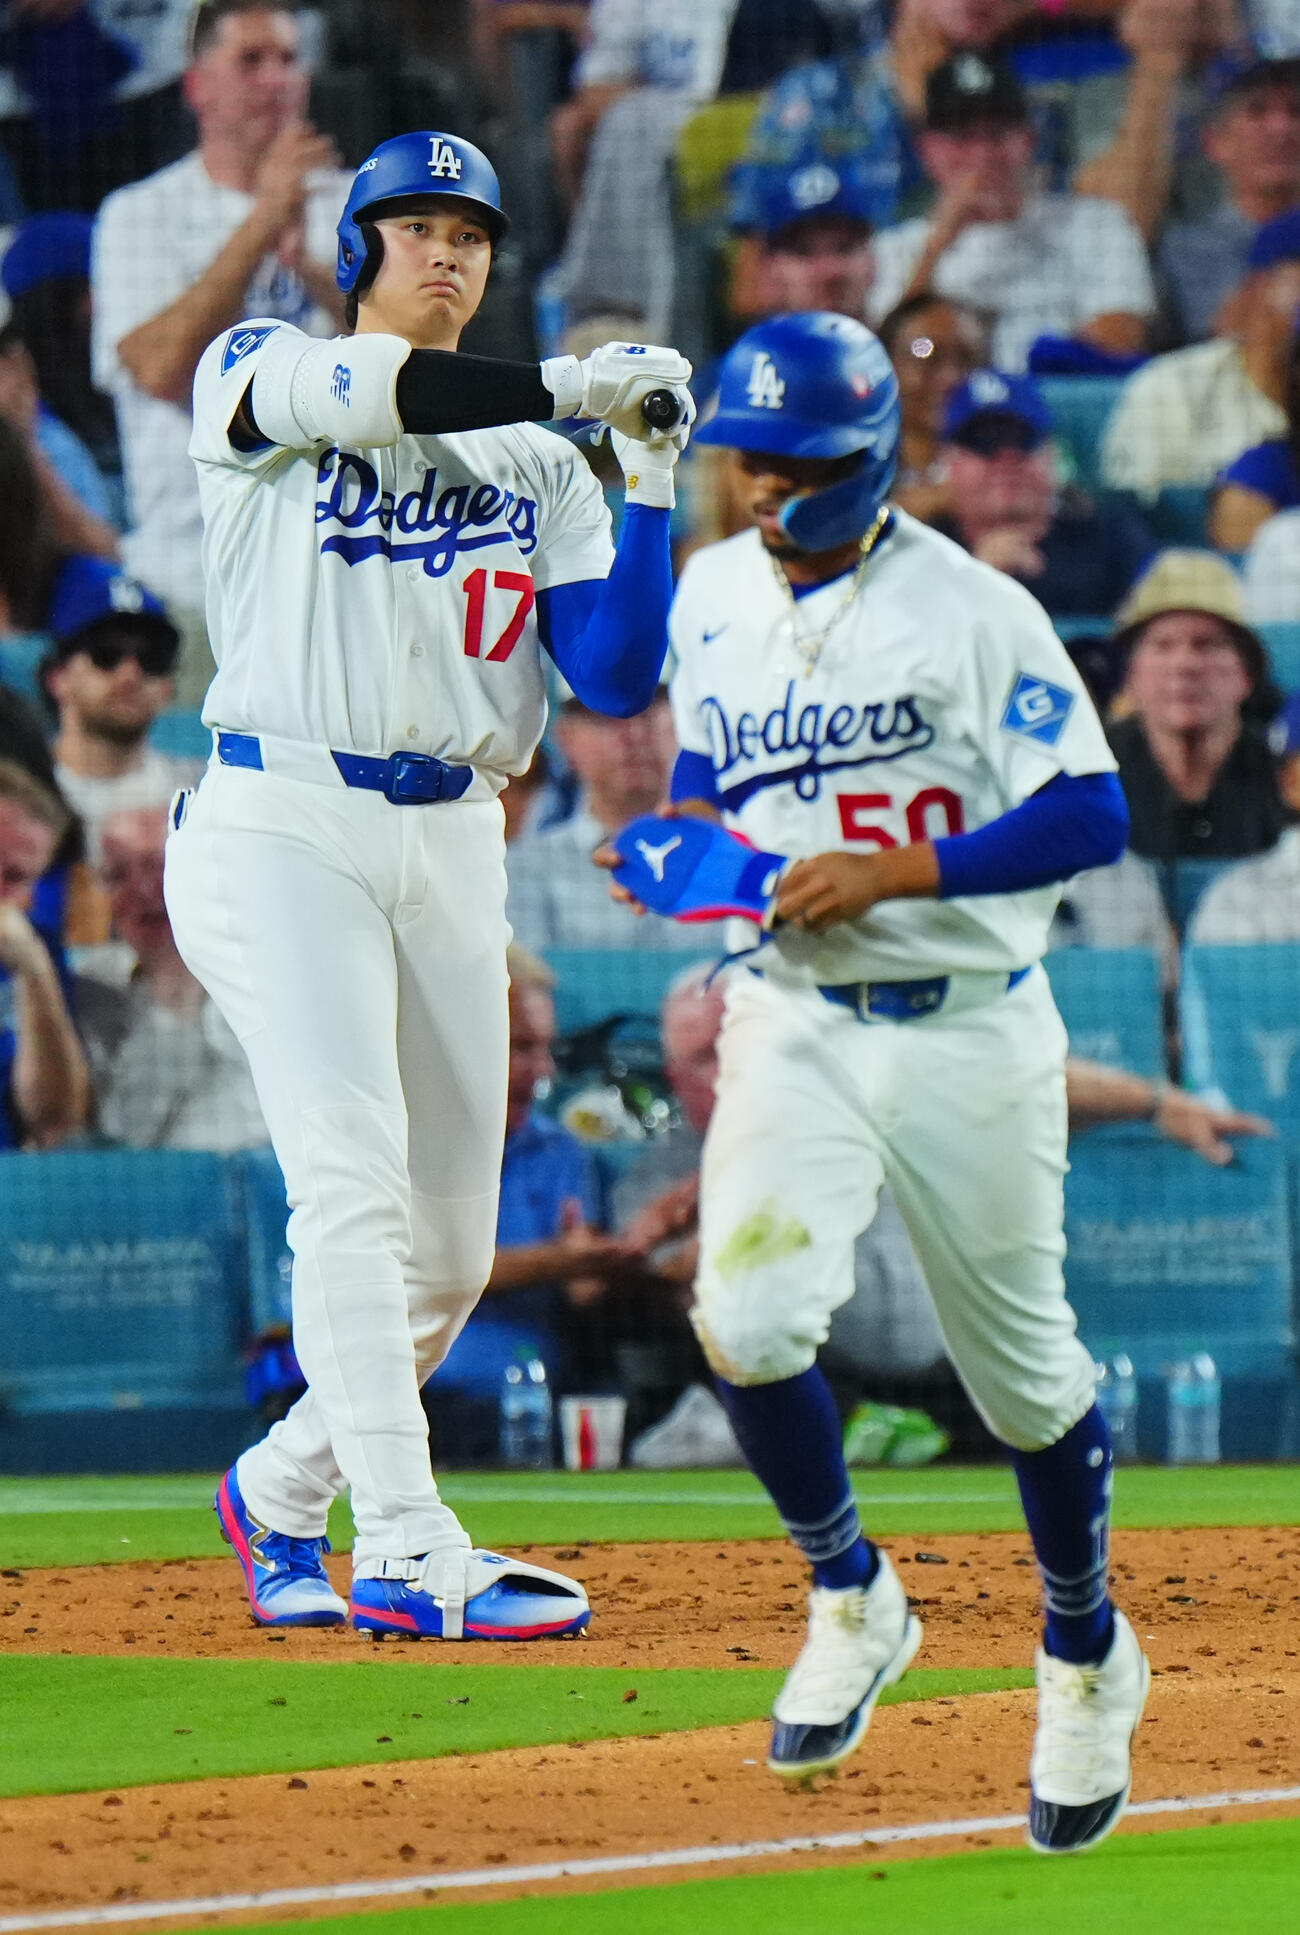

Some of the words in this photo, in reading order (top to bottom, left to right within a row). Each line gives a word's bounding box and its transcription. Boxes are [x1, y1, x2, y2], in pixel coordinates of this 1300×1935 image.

[427, 137, 462, 180] LA
[745, 351, 786, 410] LA
[315, 446, 538, 578] Dodgers
[463, 567, 536, 663] 17
[699, 679, 934, 803] Dodgers
[836, 786, 965, 851] 50
